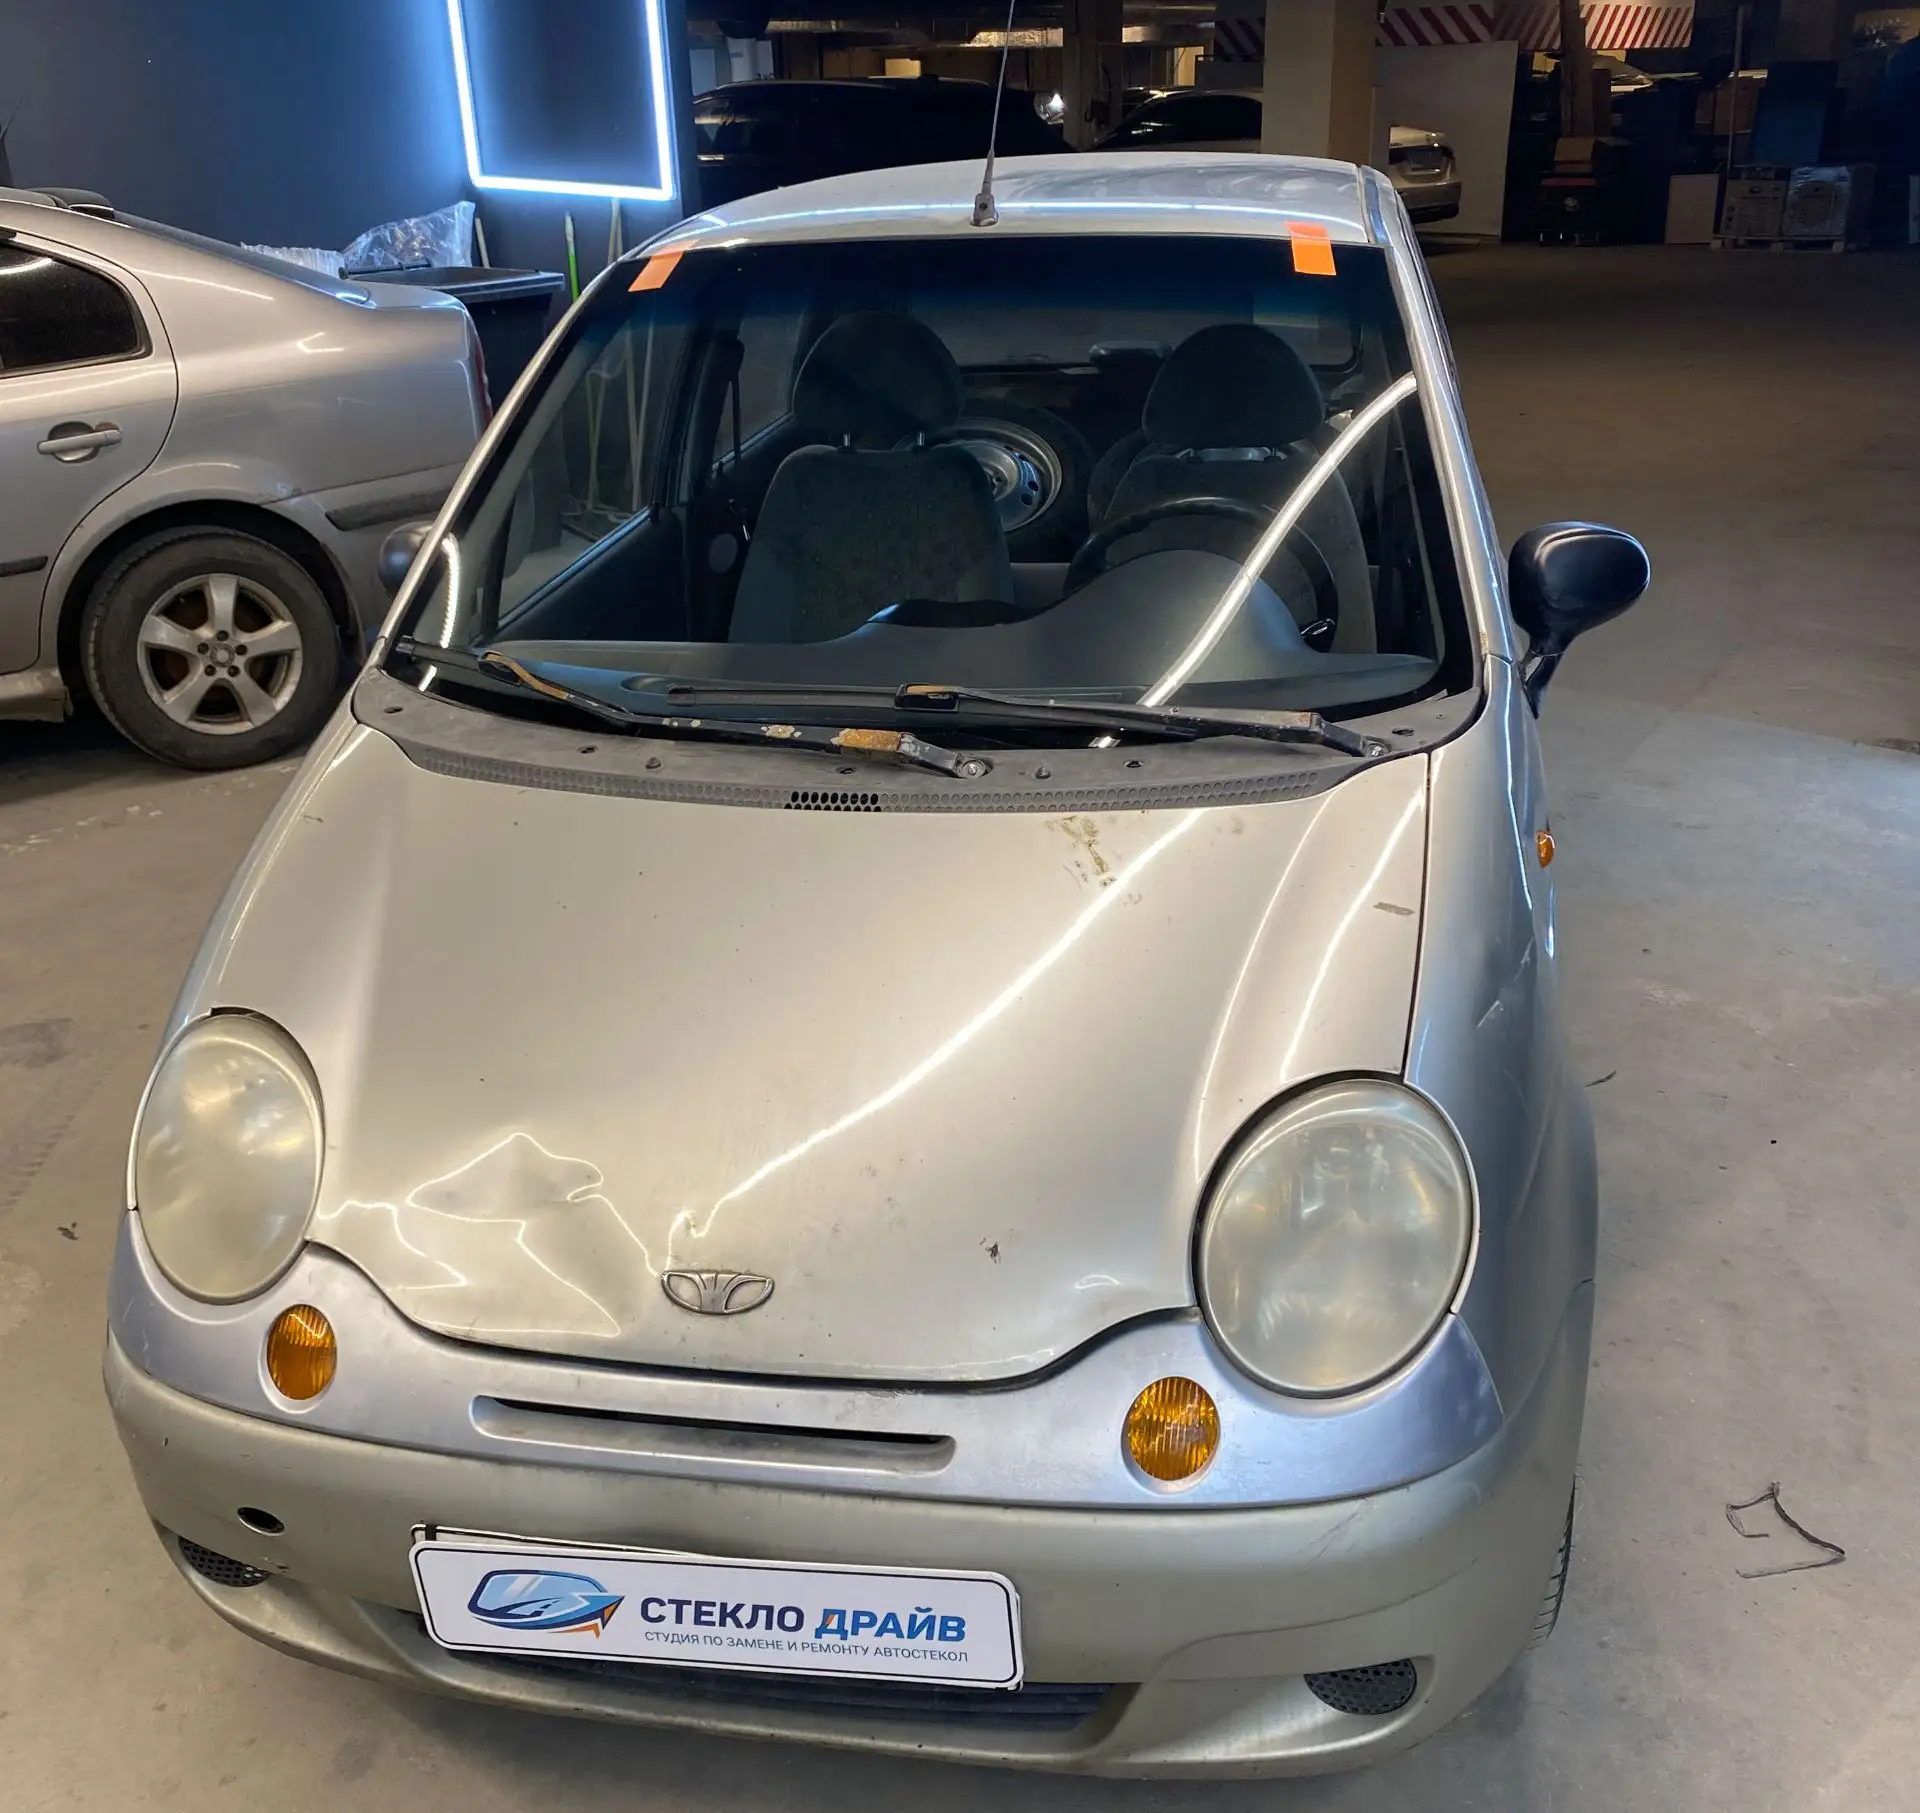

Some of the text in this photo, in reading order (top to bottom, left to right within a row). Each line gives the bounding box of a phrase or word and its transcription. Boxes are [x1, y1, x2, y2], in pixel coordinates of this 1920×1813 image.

[640, 1597, 967, 1643] СТЕКЛО ДРАЙВ
[644, 1631, 969, 1662] СТУДИЯ ПО ЗАМЕНЕ И РЕМОНТУ АВТОСТЕКОЛ
